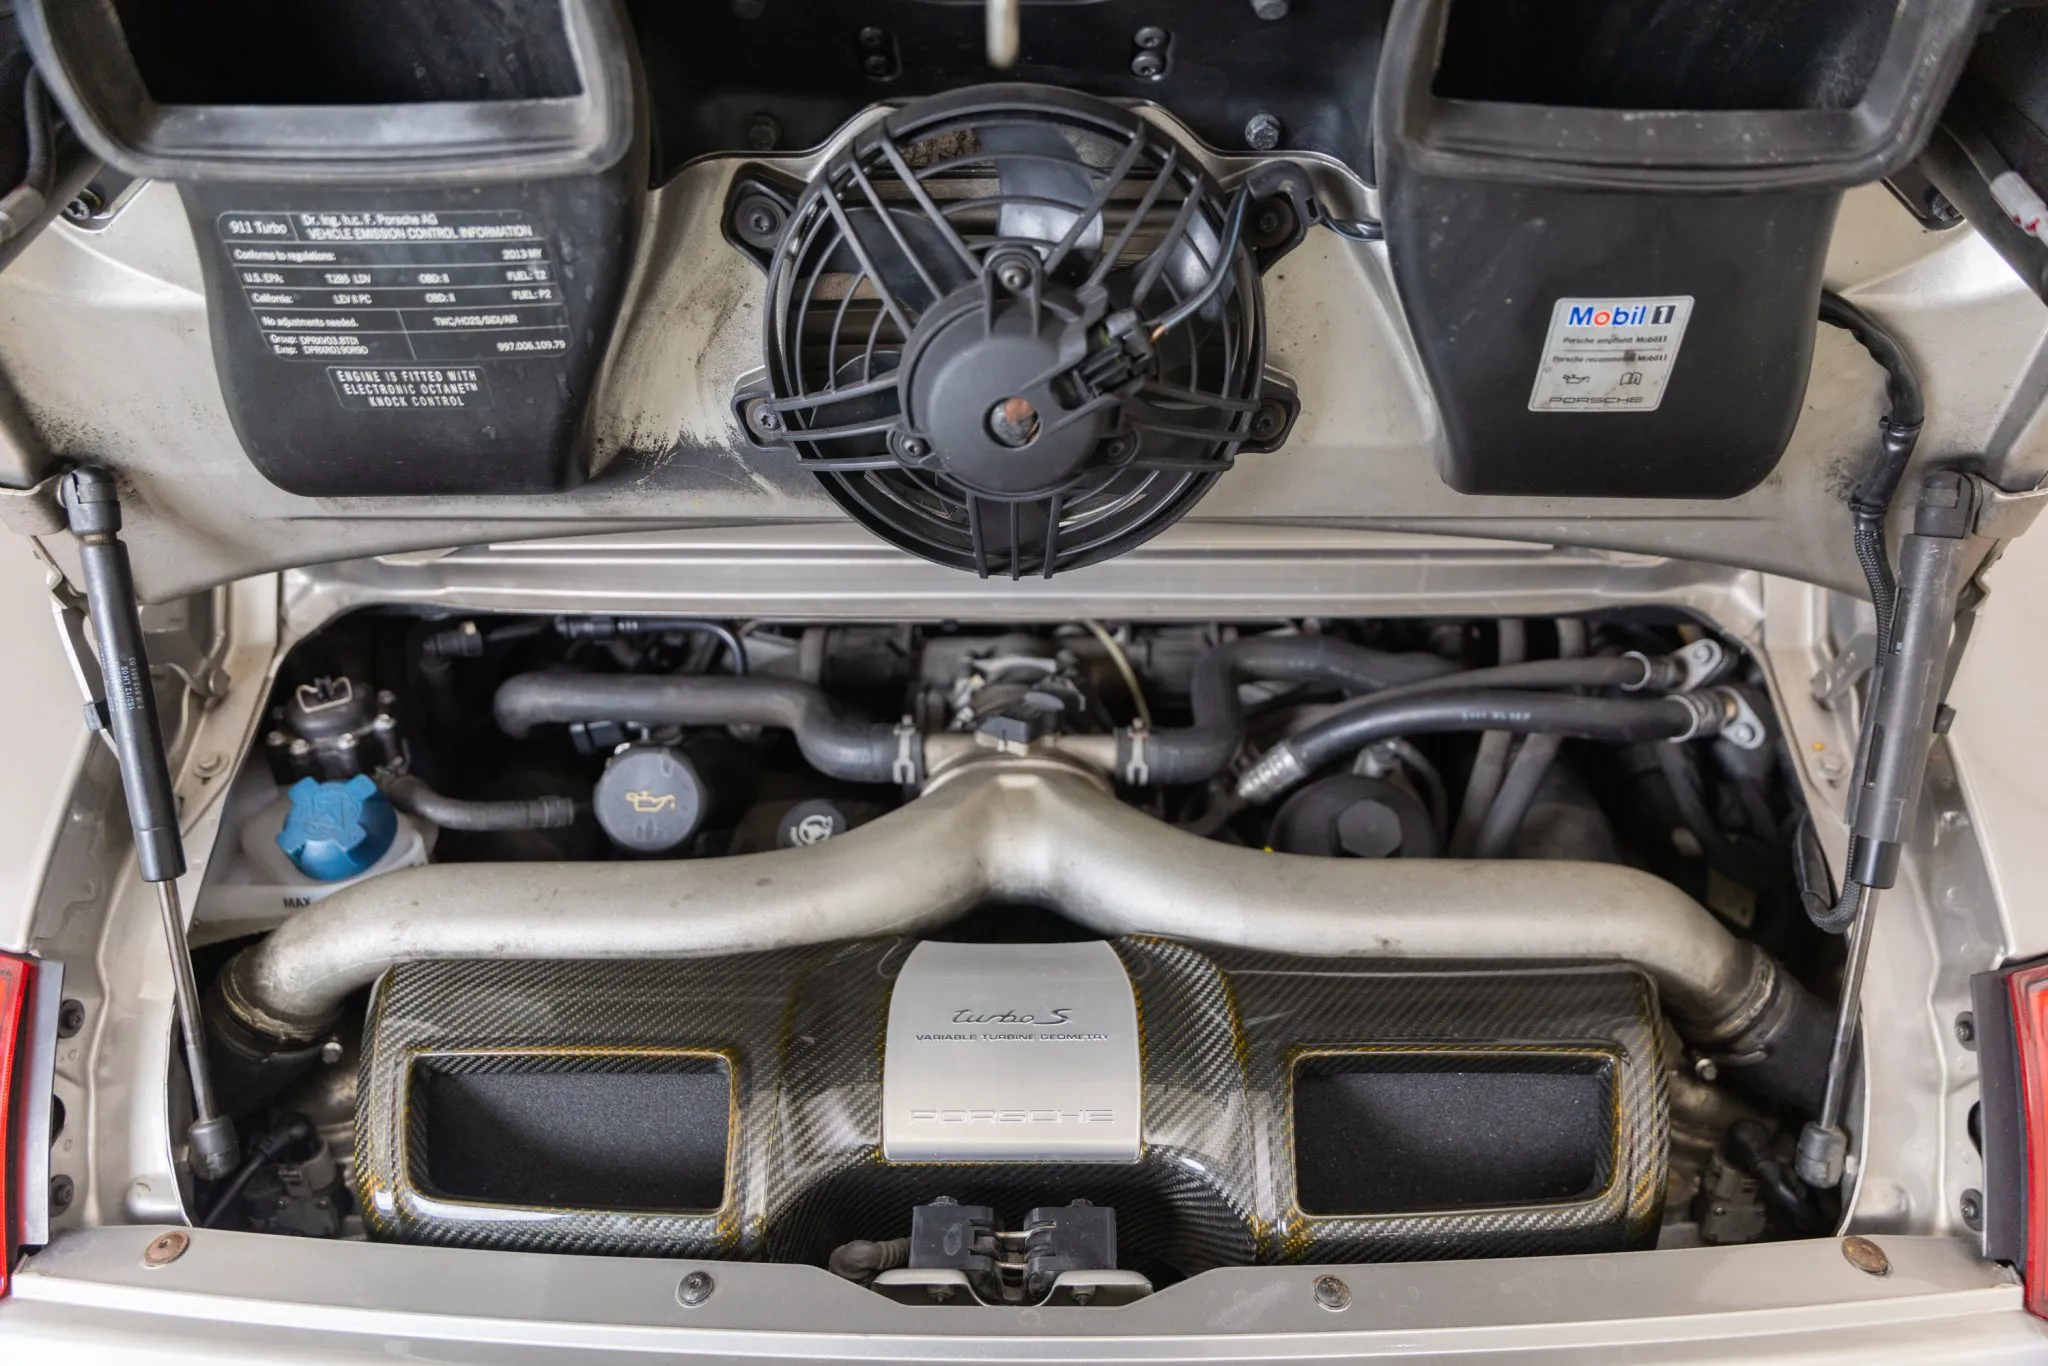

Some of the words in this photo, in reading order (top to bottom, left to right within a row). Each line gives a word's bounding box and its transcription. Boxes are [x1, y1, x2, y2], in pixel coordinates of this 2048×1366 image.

[302, 213, 320, 226] Dr.
[375, 213, 420, 226] Porsche
[229, 220, 253, 234] 911
[254, 221, 288, 235] Turbo
[306, 227, 353, 241] VEHICLE
[352, 227, 407, 241] EMISSION
[406, 226, 459, 240] CONTROL
[459, 225, 533, 239] INFORMATION
[233, 248, 276, 261] Conforms
[276, 250, 287, 261] to
[501, 249, 528, 260] 2013
[528, 248, 543, 259] MY
[505, 270, 533, 282] FUEL:
[533, 269, 548, 281] T2
[251, 292, 294, 304] California:
[358, 293, 373, 305] PC
[511, 290, 538, 301] FUEL:
[538, 288, 553, 300] P2
[261, 315, 276, 327] No
[276, 316, 325, 329] adjustments
[325, 317, 359, 328] needed.
[1568, 305, 1647, 326] Mobil
[272, 345, 299, 355] Evap:
[336, 370, 381, 383] ENGINE
[385, 370, 398, 383] IS
[401, 370, 444, 383] FITTED
[446, 370, 478, 382] WITH
[342, 383, 416, 395] ELECTRONIC
[367, 395, 408, 407] KNOCK
[411, 395, 465, 407] CONTROL
[1549, 396, 1645, 404] PORSCHE
[282, 896, 311, 909] MAX
[1033, 1008, 1072, 1025] S
[909, 1109, 1115, 1125] PORSCHE
